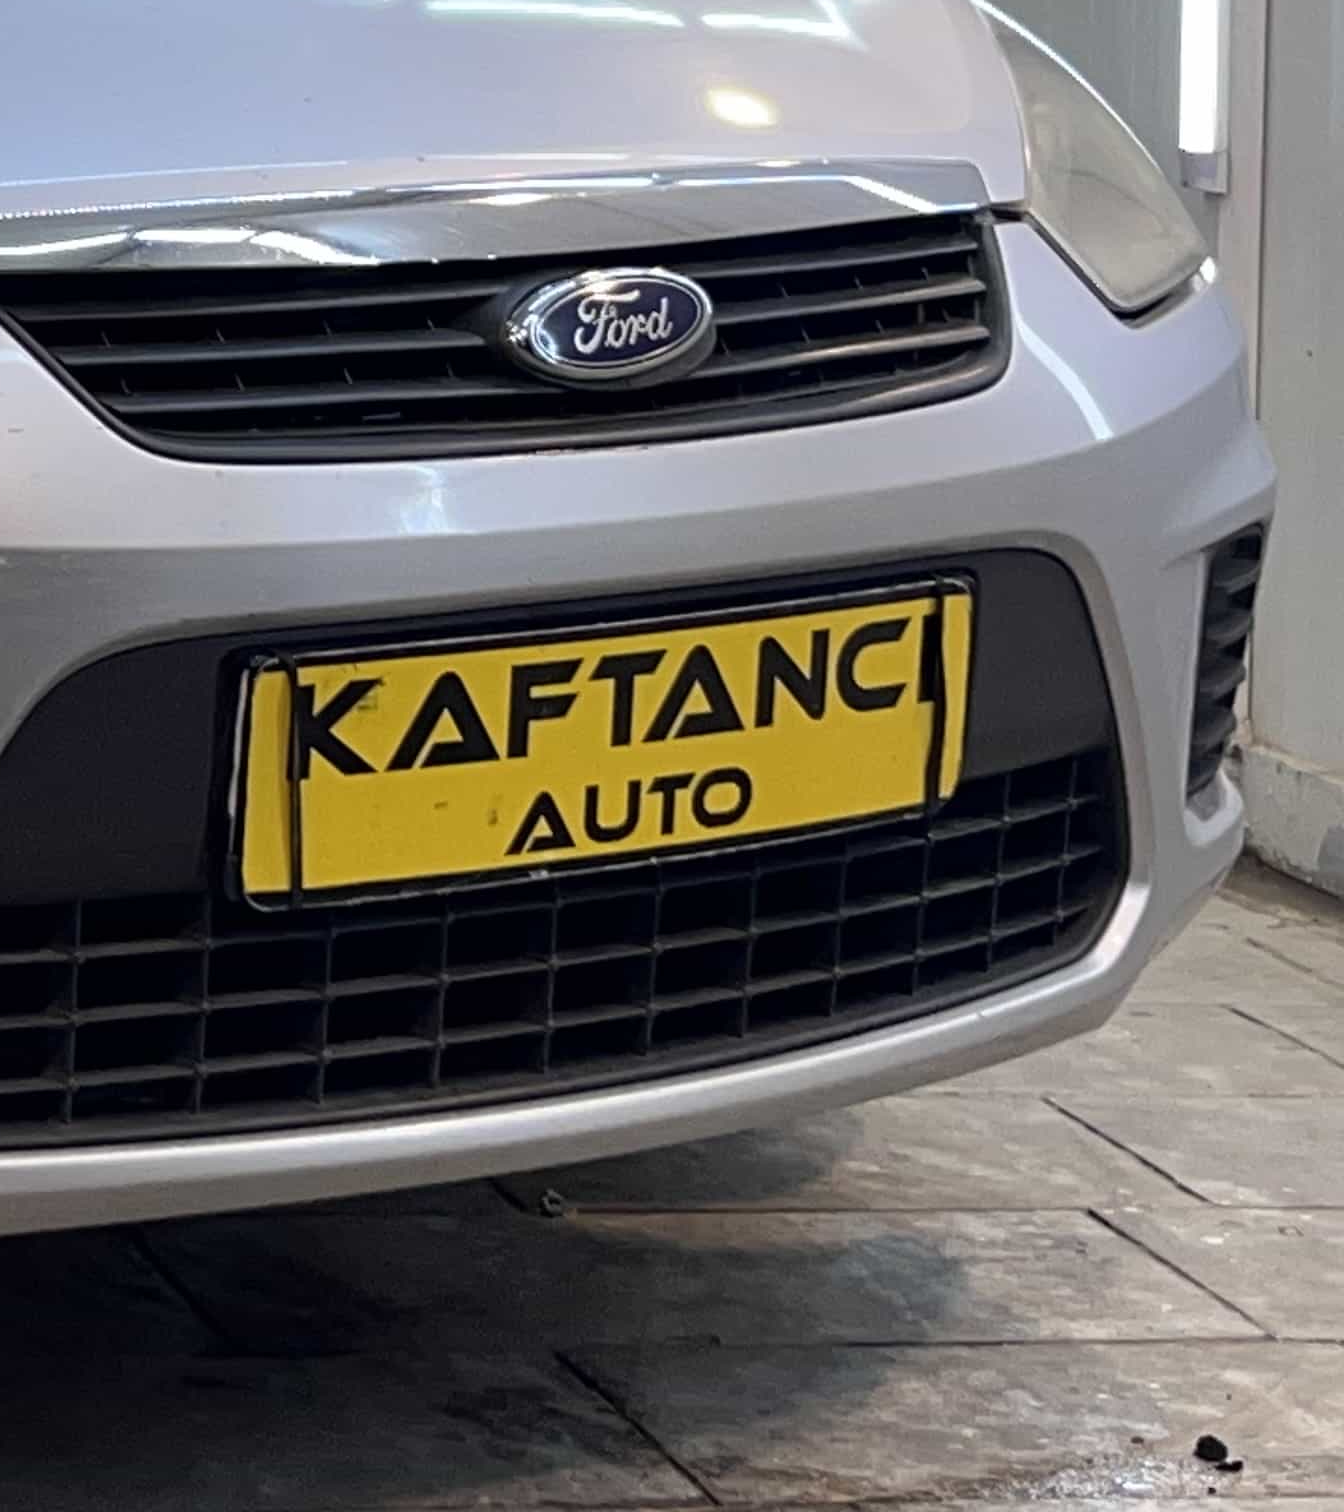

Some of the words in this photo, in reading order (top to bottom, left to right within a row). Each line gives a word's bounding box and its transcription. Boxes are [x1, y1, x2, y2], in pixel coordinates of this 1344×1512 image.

[574, 289, 673, 355] Ford
[288, 615, 942, 780] KAFTANCI
[504, 766, 753, 856] AUTO
